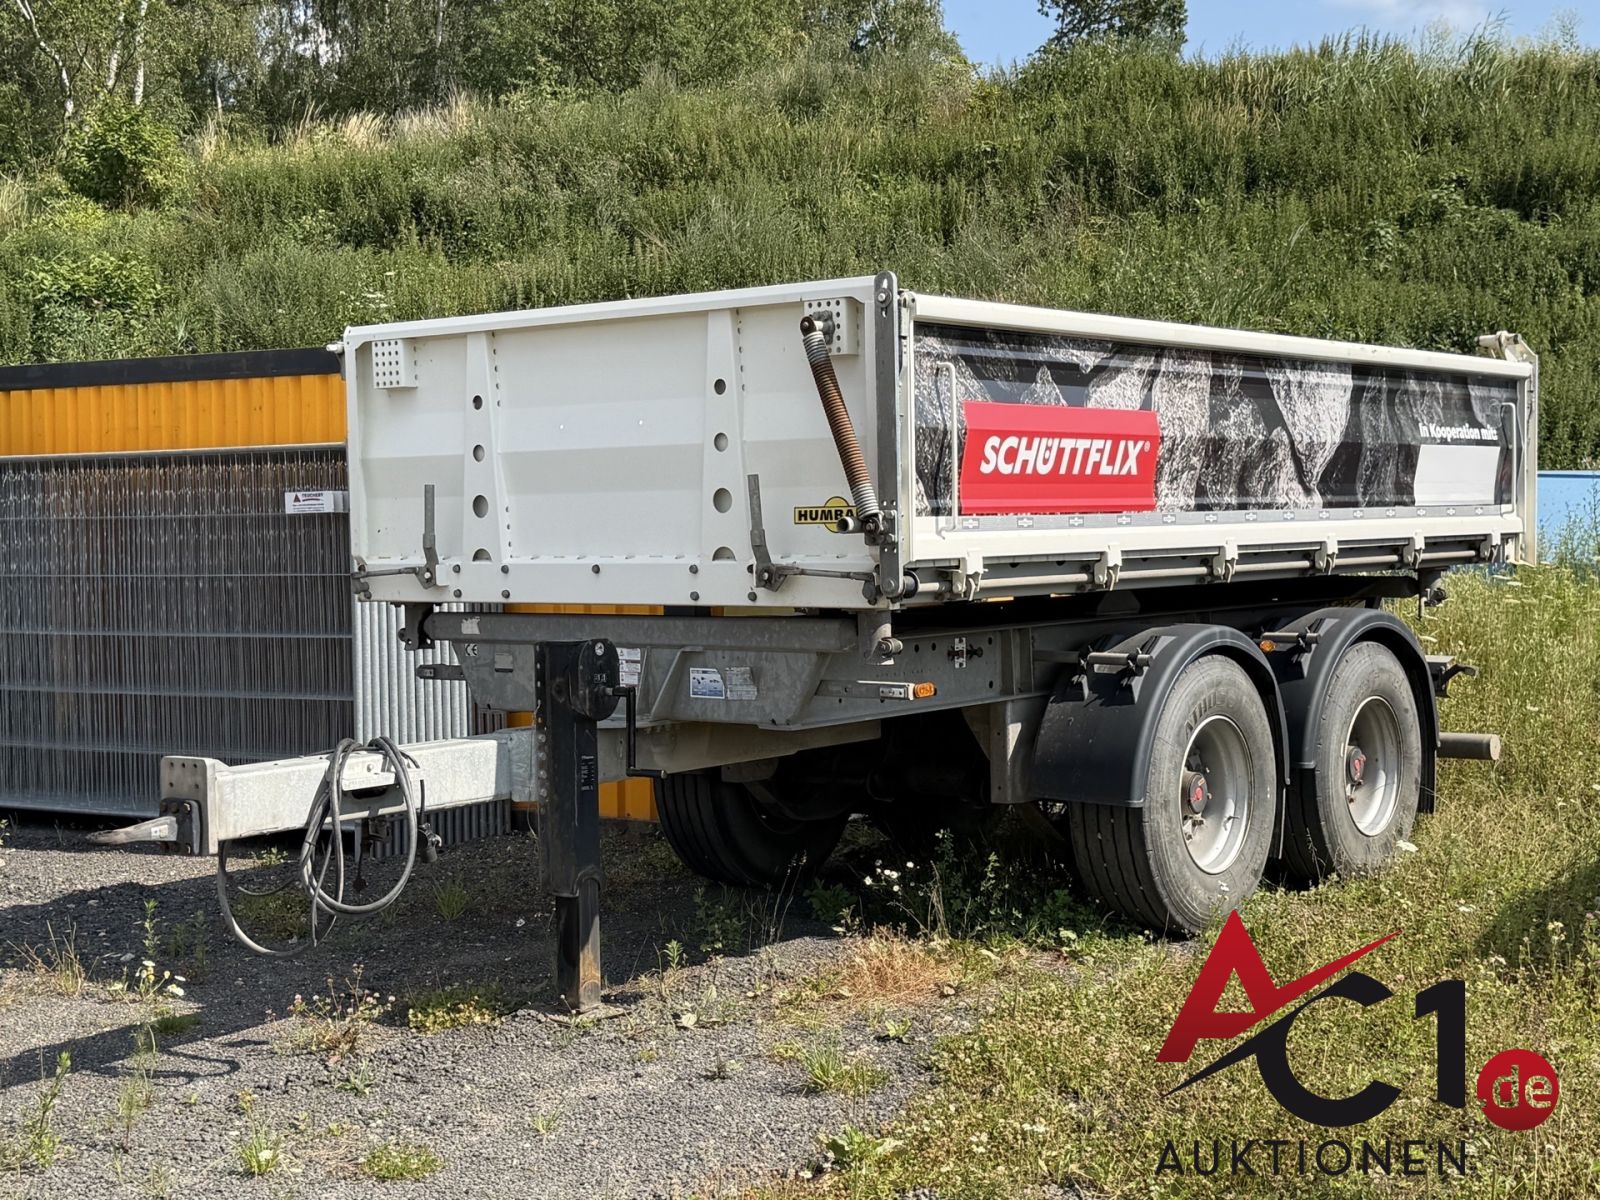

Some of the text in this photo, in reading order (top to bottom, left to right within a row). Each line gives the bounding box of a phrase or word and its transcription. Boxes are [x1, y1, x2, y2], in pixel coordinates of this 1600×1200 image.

[1429, 422, 1480, 442] Kooperation
[1480, 424, 1498, 440] mit:
[798, 508, 857, 521] HUMBA
